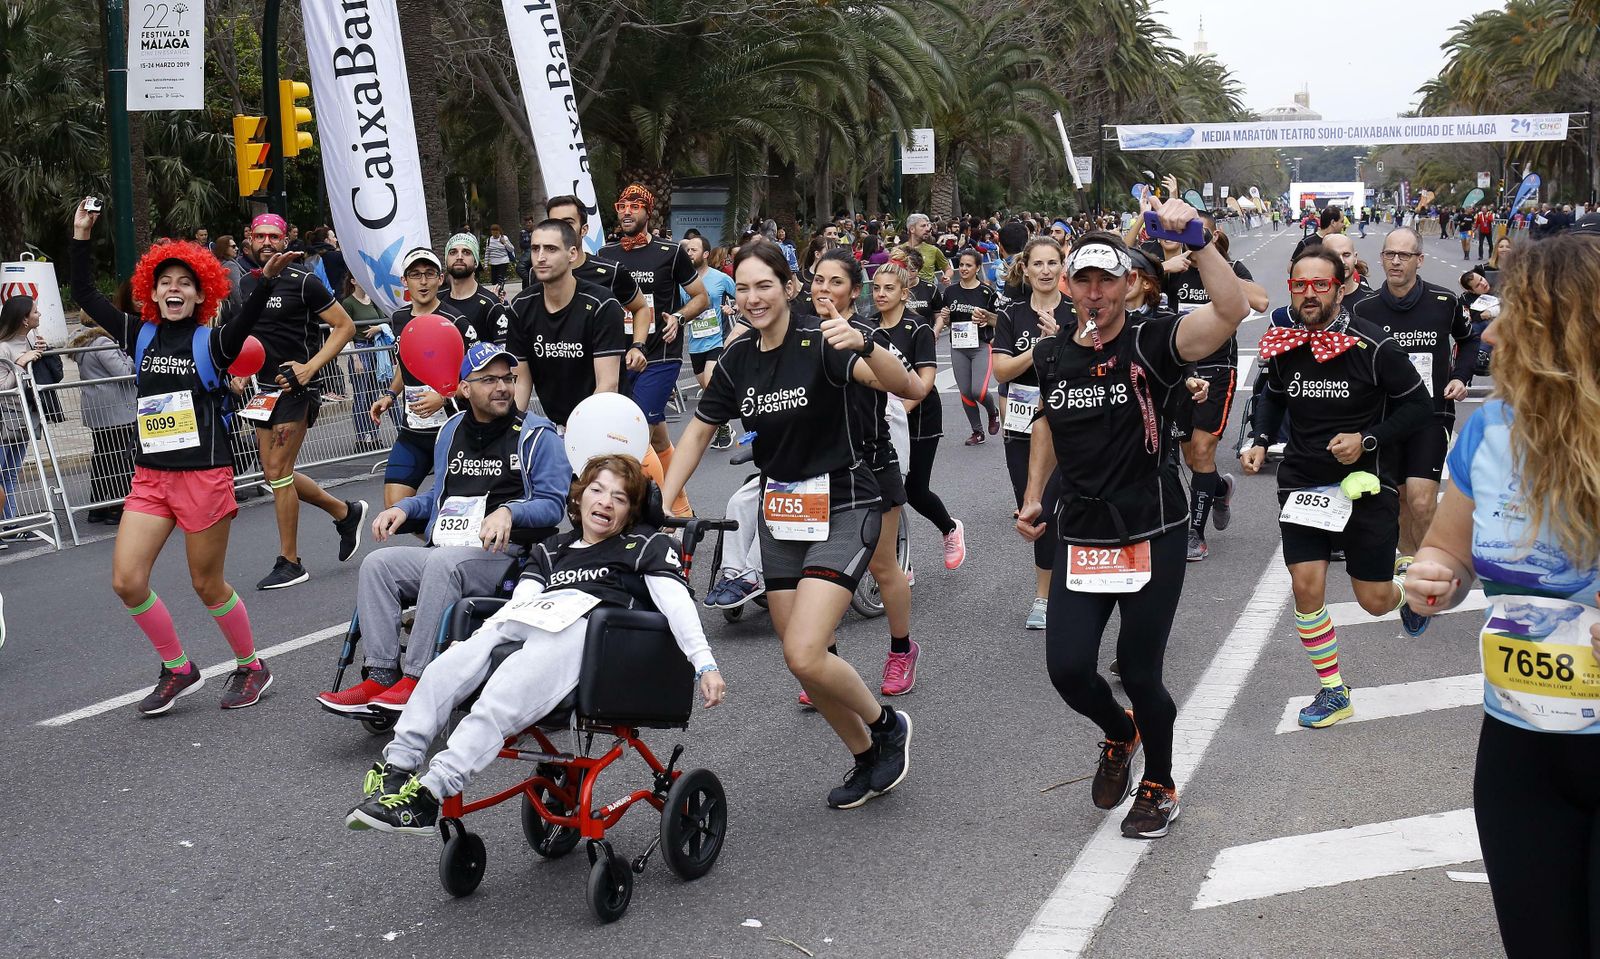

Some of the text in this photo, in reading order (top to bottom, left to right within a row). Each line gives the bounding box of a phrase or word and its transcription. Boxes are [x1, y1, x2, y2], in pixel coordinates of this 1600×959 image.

[143, 3, 169, 28] 22
[141, 29, 190, 38] FESTIVAL DE
[141, 37, 190, 50] MÁLAGA
[333, 0, 398, 230] CaixaBa
[1202, 122, 1497, 142] MEDIA MARATÓN TEATRO SOHO-CAIXABANK CIUDAD DE MÁLAGA
[1302, 380, 1349, 390] EGOÍSMO
[757, 386, 806, 405] EGOÍSMO
[1302, 389, 1350, 399] POSITIVO
[757, 396, 809, 415] POSITIVO
[145, 415, 176, 432] 6099
[463, 457, 503, 468] EGOÍSMO
[462, 467, 502, 477] POSITIVO
[768, 496, 804, 514] 4755
[1295, 493, 1331, 509] 9853
[440, 518, 469, 531] 9320
[1077, 548, 1122, 567] 3327
[1498, 645, 1575, 683] 7658
